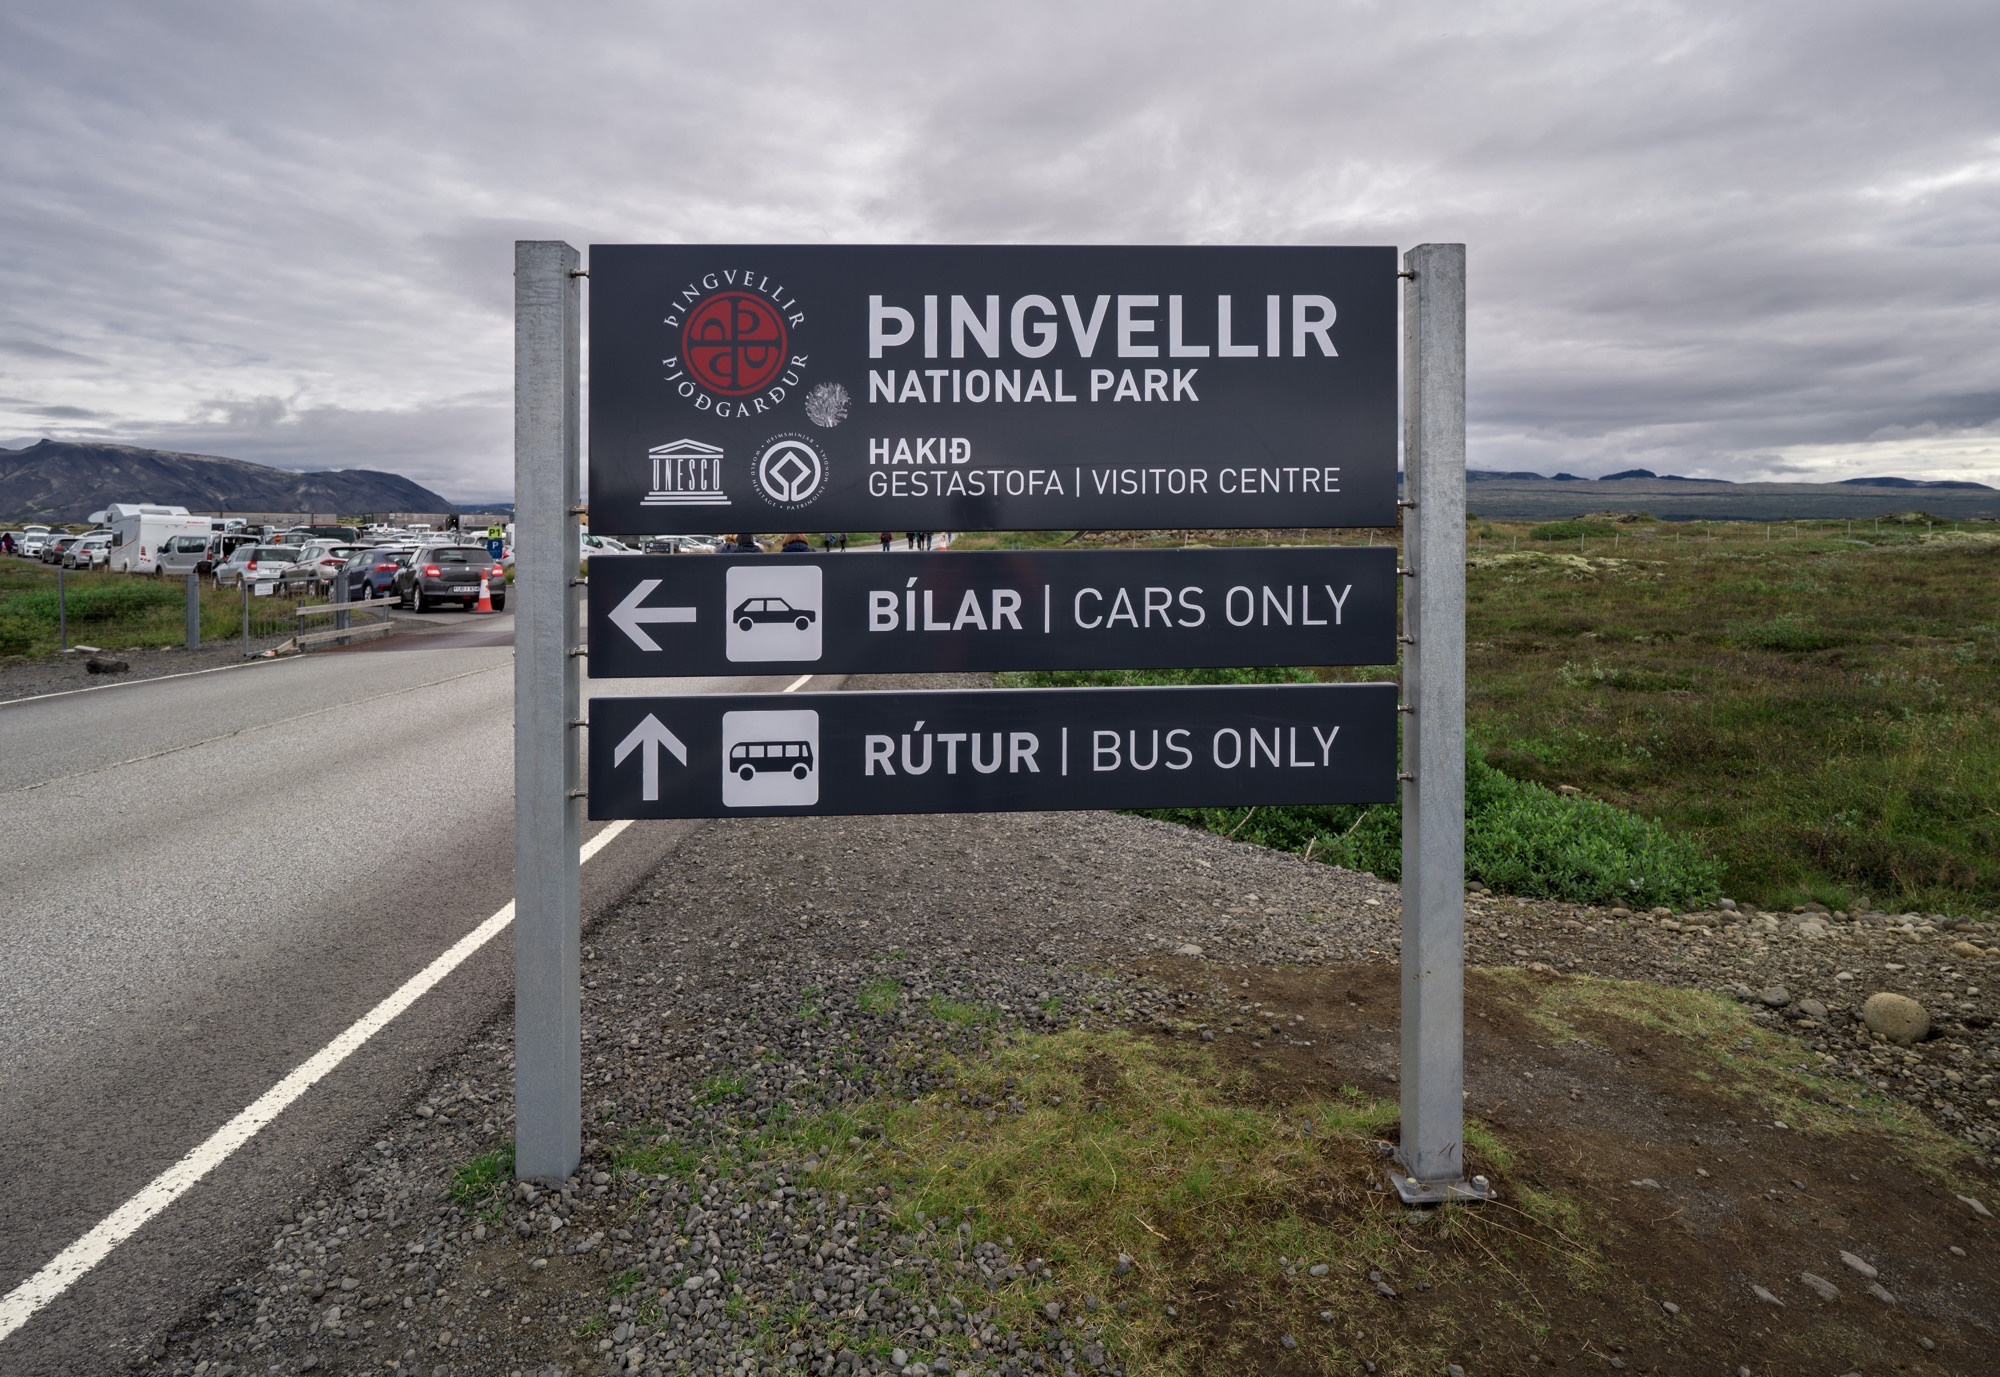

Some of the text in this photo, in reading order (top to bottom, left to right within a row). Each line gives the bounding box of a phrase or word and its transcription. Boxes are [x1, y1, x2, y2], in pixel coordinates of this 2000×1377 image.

[663, 269, 806, 329] ÞINGVELLIR
[868, 294, 1339, 359] ÞINGVELLIR
[869, 368, 1200, 404] NATIONAL PARK
[766, 431, 814, 444] HEIMSMINJAR
[869, 437, 972, 465] HAKIÐ
[652, 458, 721, 492] UNESCO
[750, 450, 777, 507] WORLD HERITAGE
[786, 449, 830, 510] PATRIMOINE MONDIAL
[868, 467, 1341, 497] GESTASTOFA VISITOR CENTRE
[489, 528, 501, 537] P1
[868, 576, 1353, 632] BÍLAR CARS ONLY
[865, 720, 1340, 776] RÚTUR BUS ONLY
